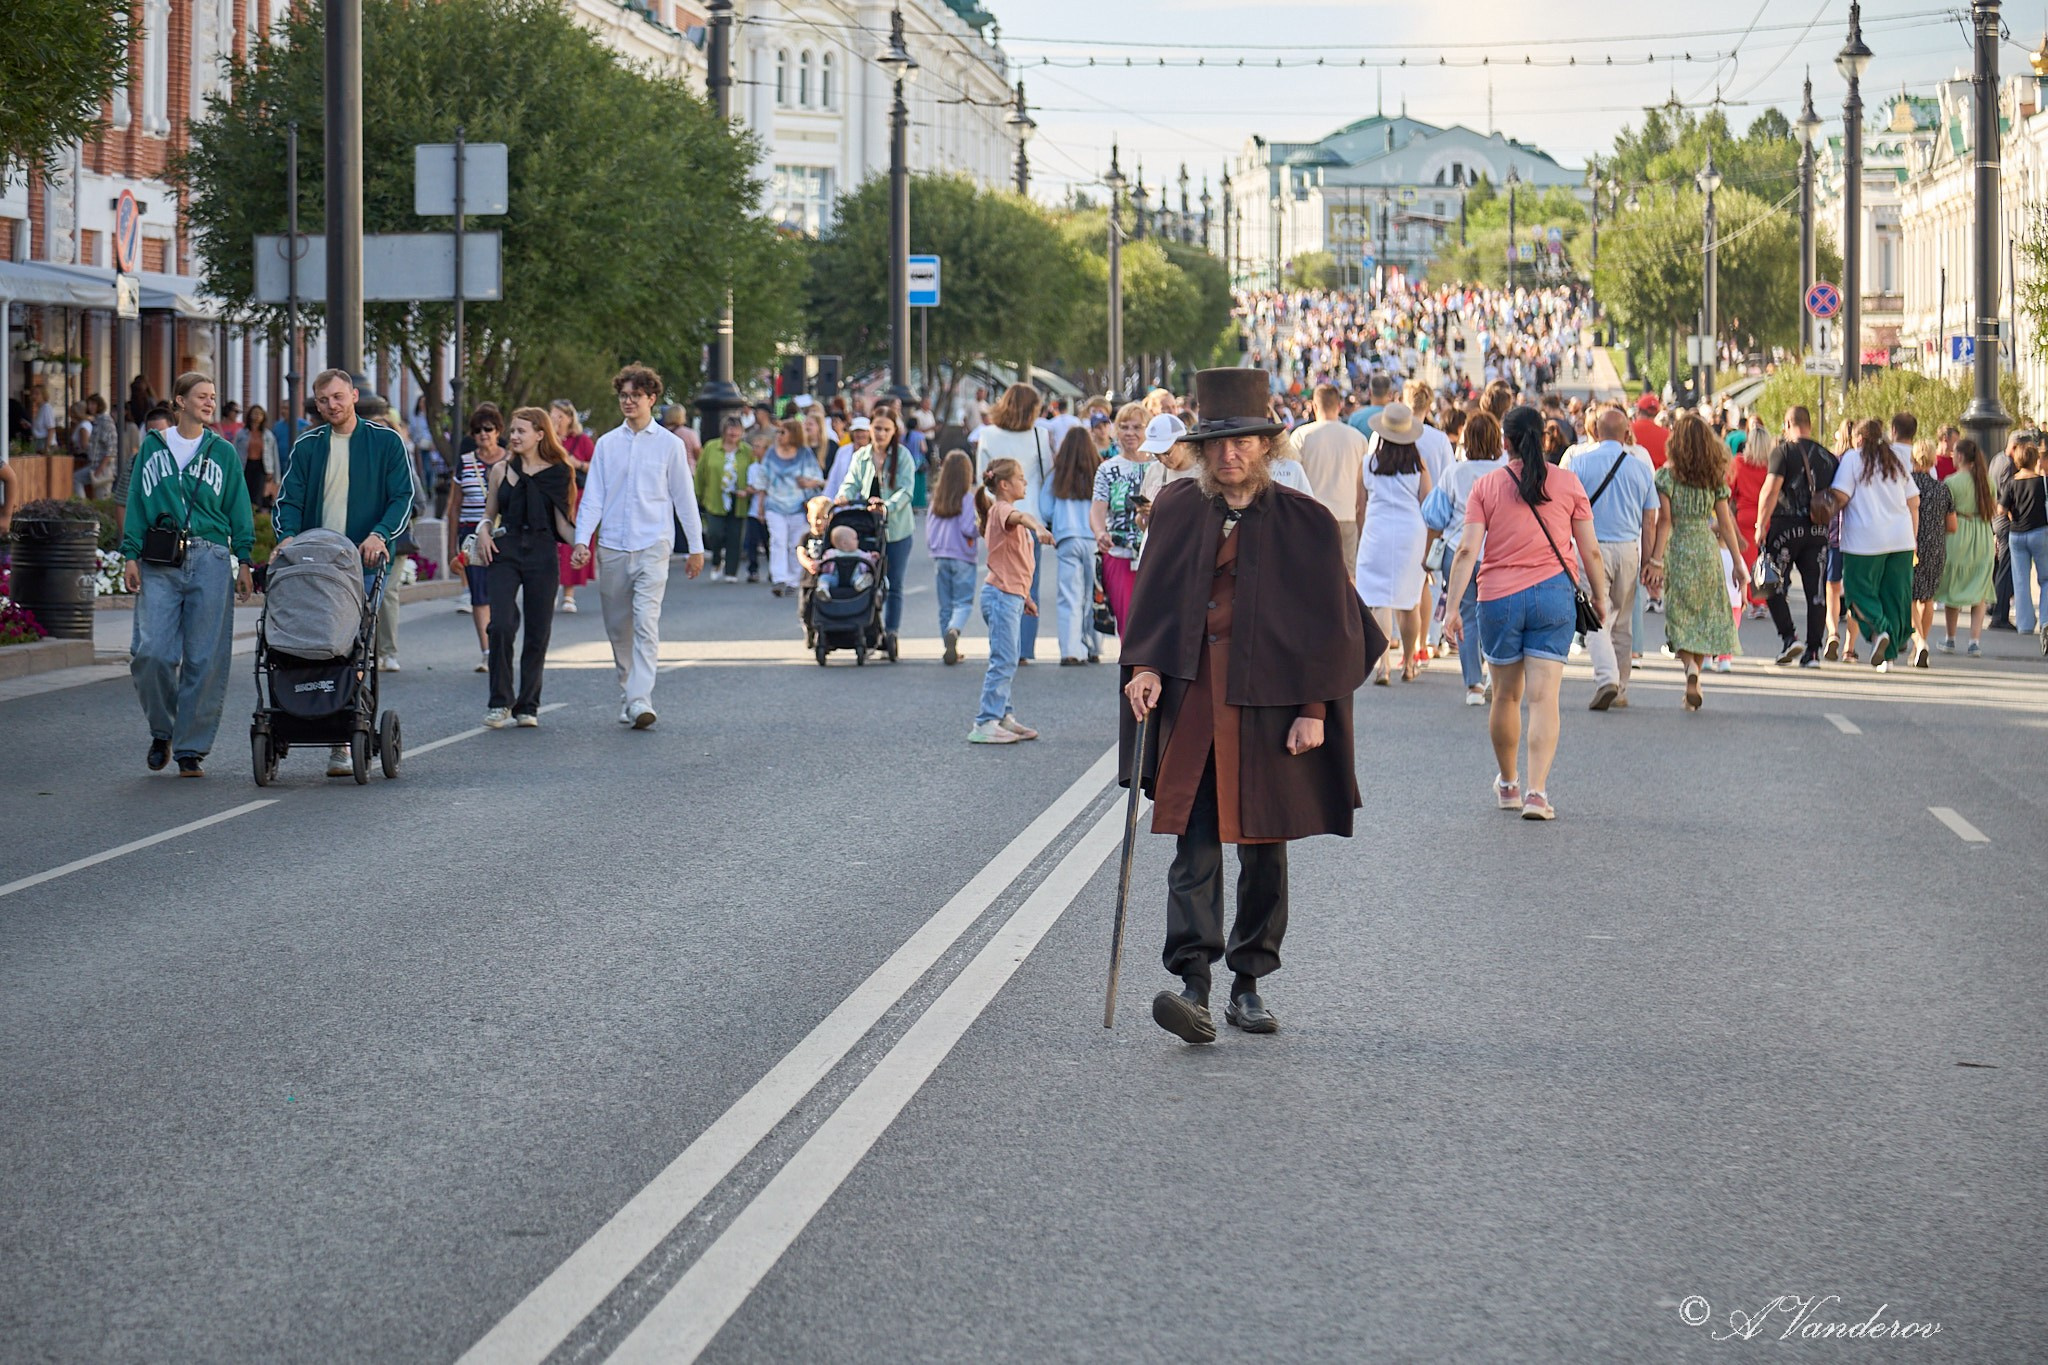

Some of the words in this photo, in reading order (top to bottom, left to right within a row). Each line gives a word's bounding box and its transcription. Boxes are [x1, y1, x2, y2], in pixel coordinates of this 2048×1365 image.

[142, 448, 173, 497] OWN
[1773, 526, 1804, 549] DAVID
[294, 680, 335, 693] SONIC
